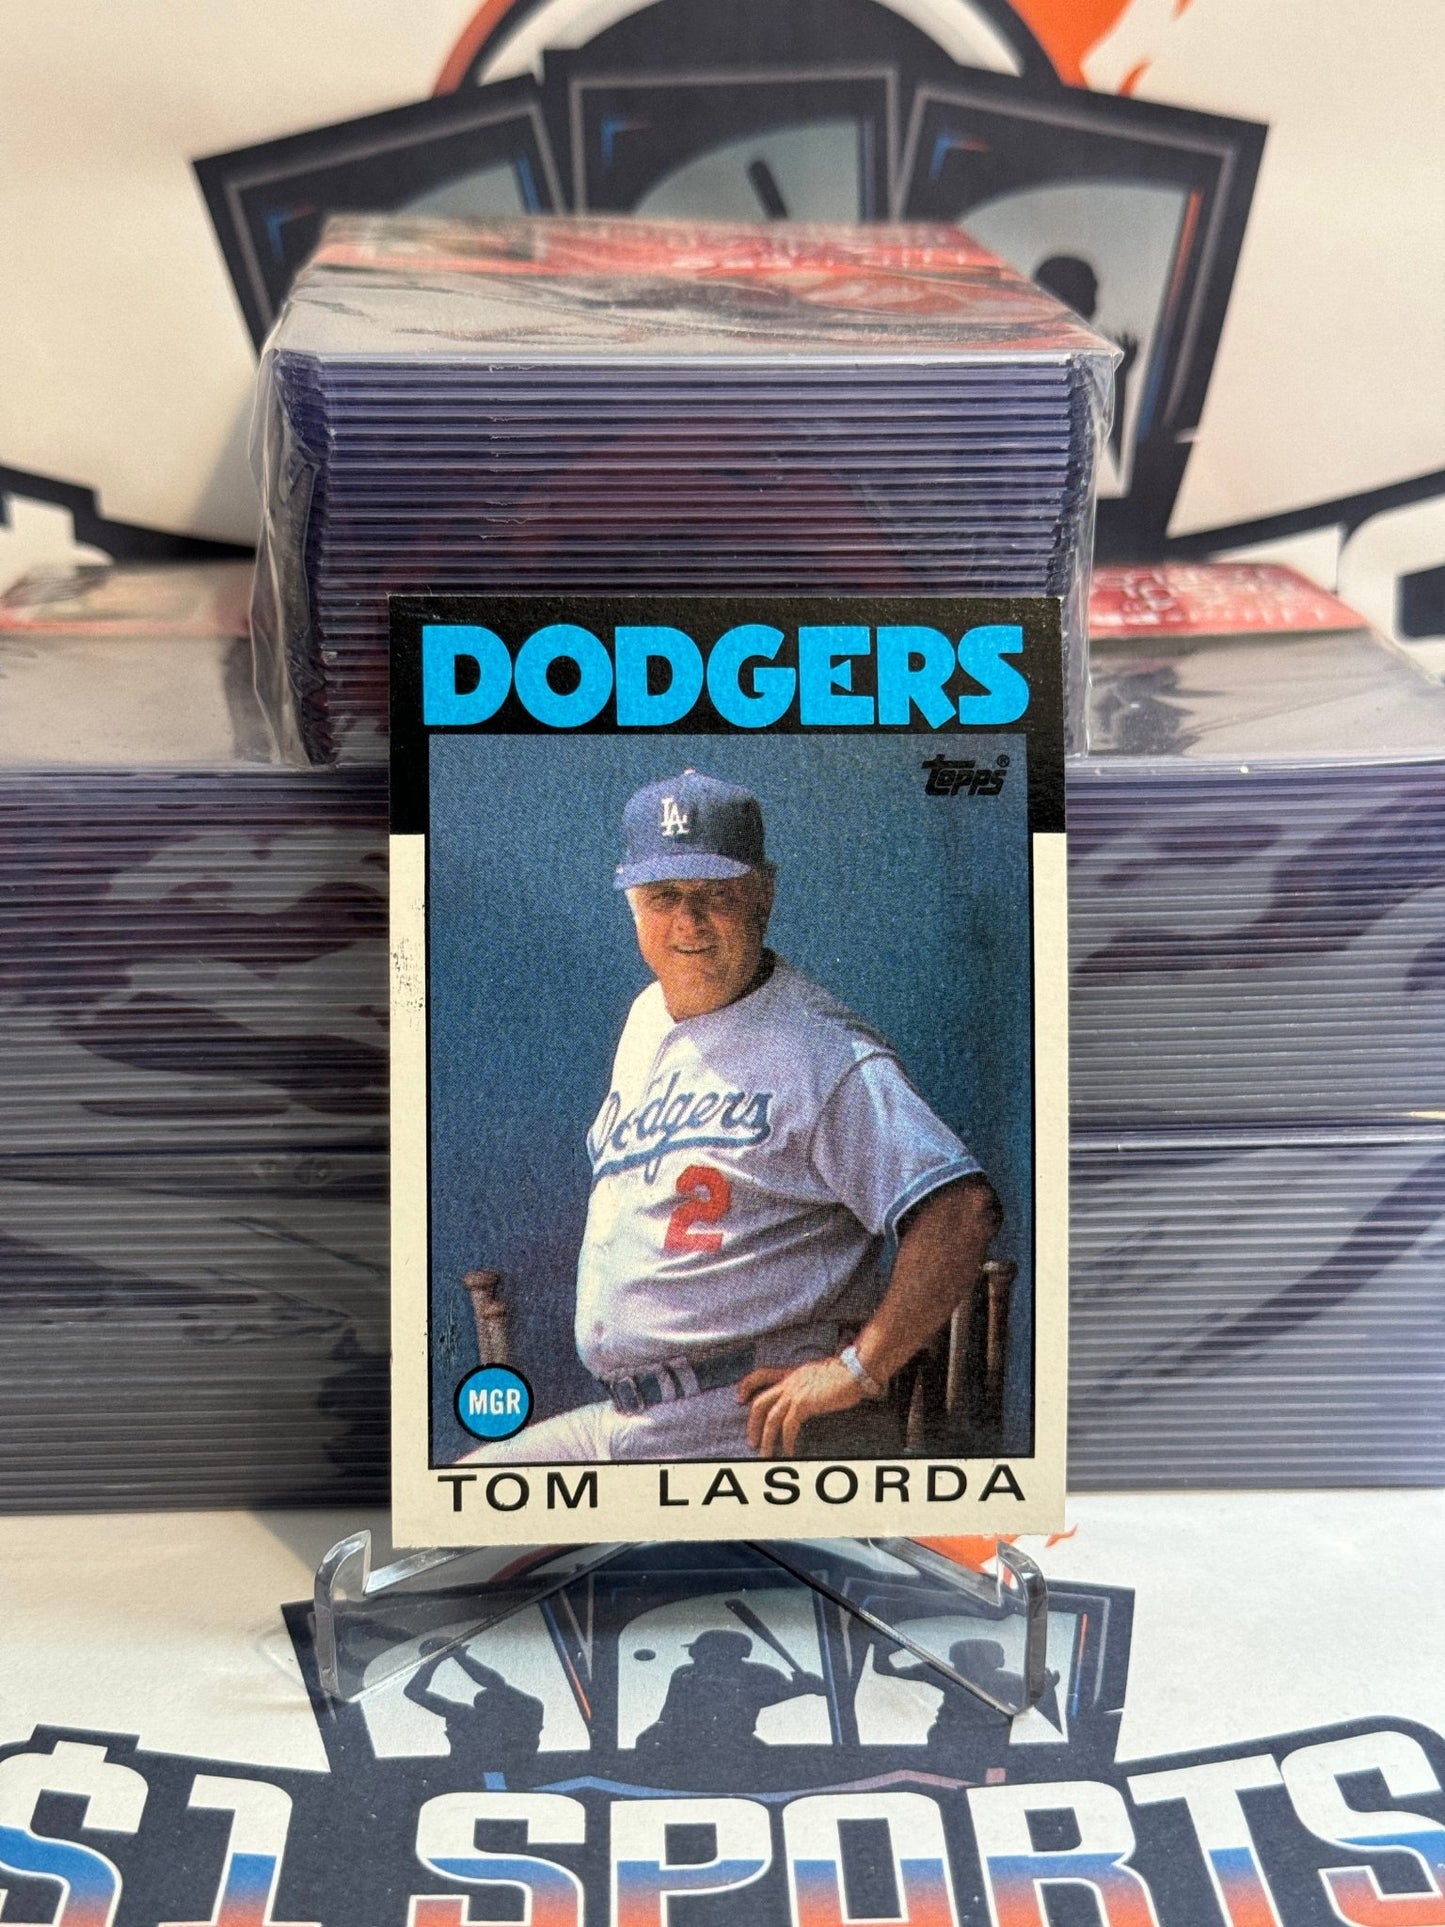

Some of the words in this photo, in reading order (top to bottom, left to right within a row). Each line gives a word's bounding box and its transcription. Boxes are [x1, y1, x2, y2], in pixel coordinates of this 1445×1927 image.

[422, 624, 1030, 729] DODGERS
[661, 797, 689, 837] LA
[587, 1071, 773, 1184] Dodgers
[664, 1164, 731, 1253] 2
[467, 1389, 522, 1416] MGR
[437, 1471, 599, 1513] TOM
[659, 1464, 1027, 1508] LASORDA
[407, 1731, 1445, 1927] SPORTS
